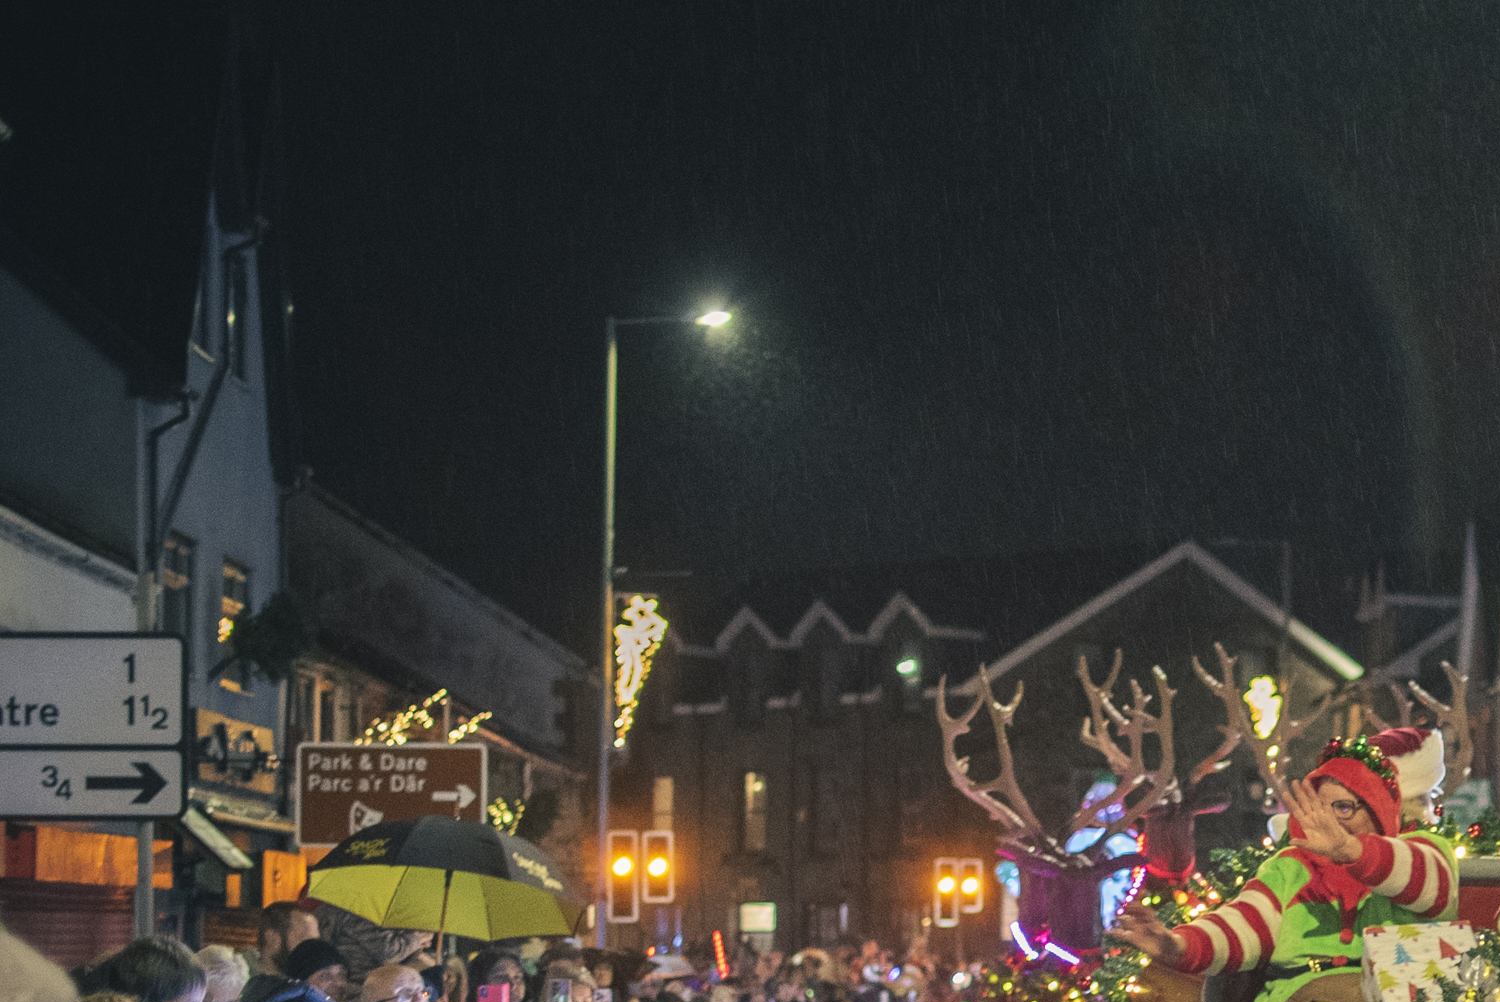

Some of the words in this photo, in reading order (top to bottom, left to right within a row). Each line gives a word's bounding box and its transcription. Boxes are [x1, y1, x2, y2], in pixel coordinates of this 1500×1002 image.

[123, 653, 136, 684] 1
[0, 695, 60, 727] tre
[307, 752, 353, 772] Park
[359, 752, 374, 772] &
[380, 752, 428, 773] Dare
[307, 774, 353, 793] Parc
[357, 774, 384, 793] a'r
